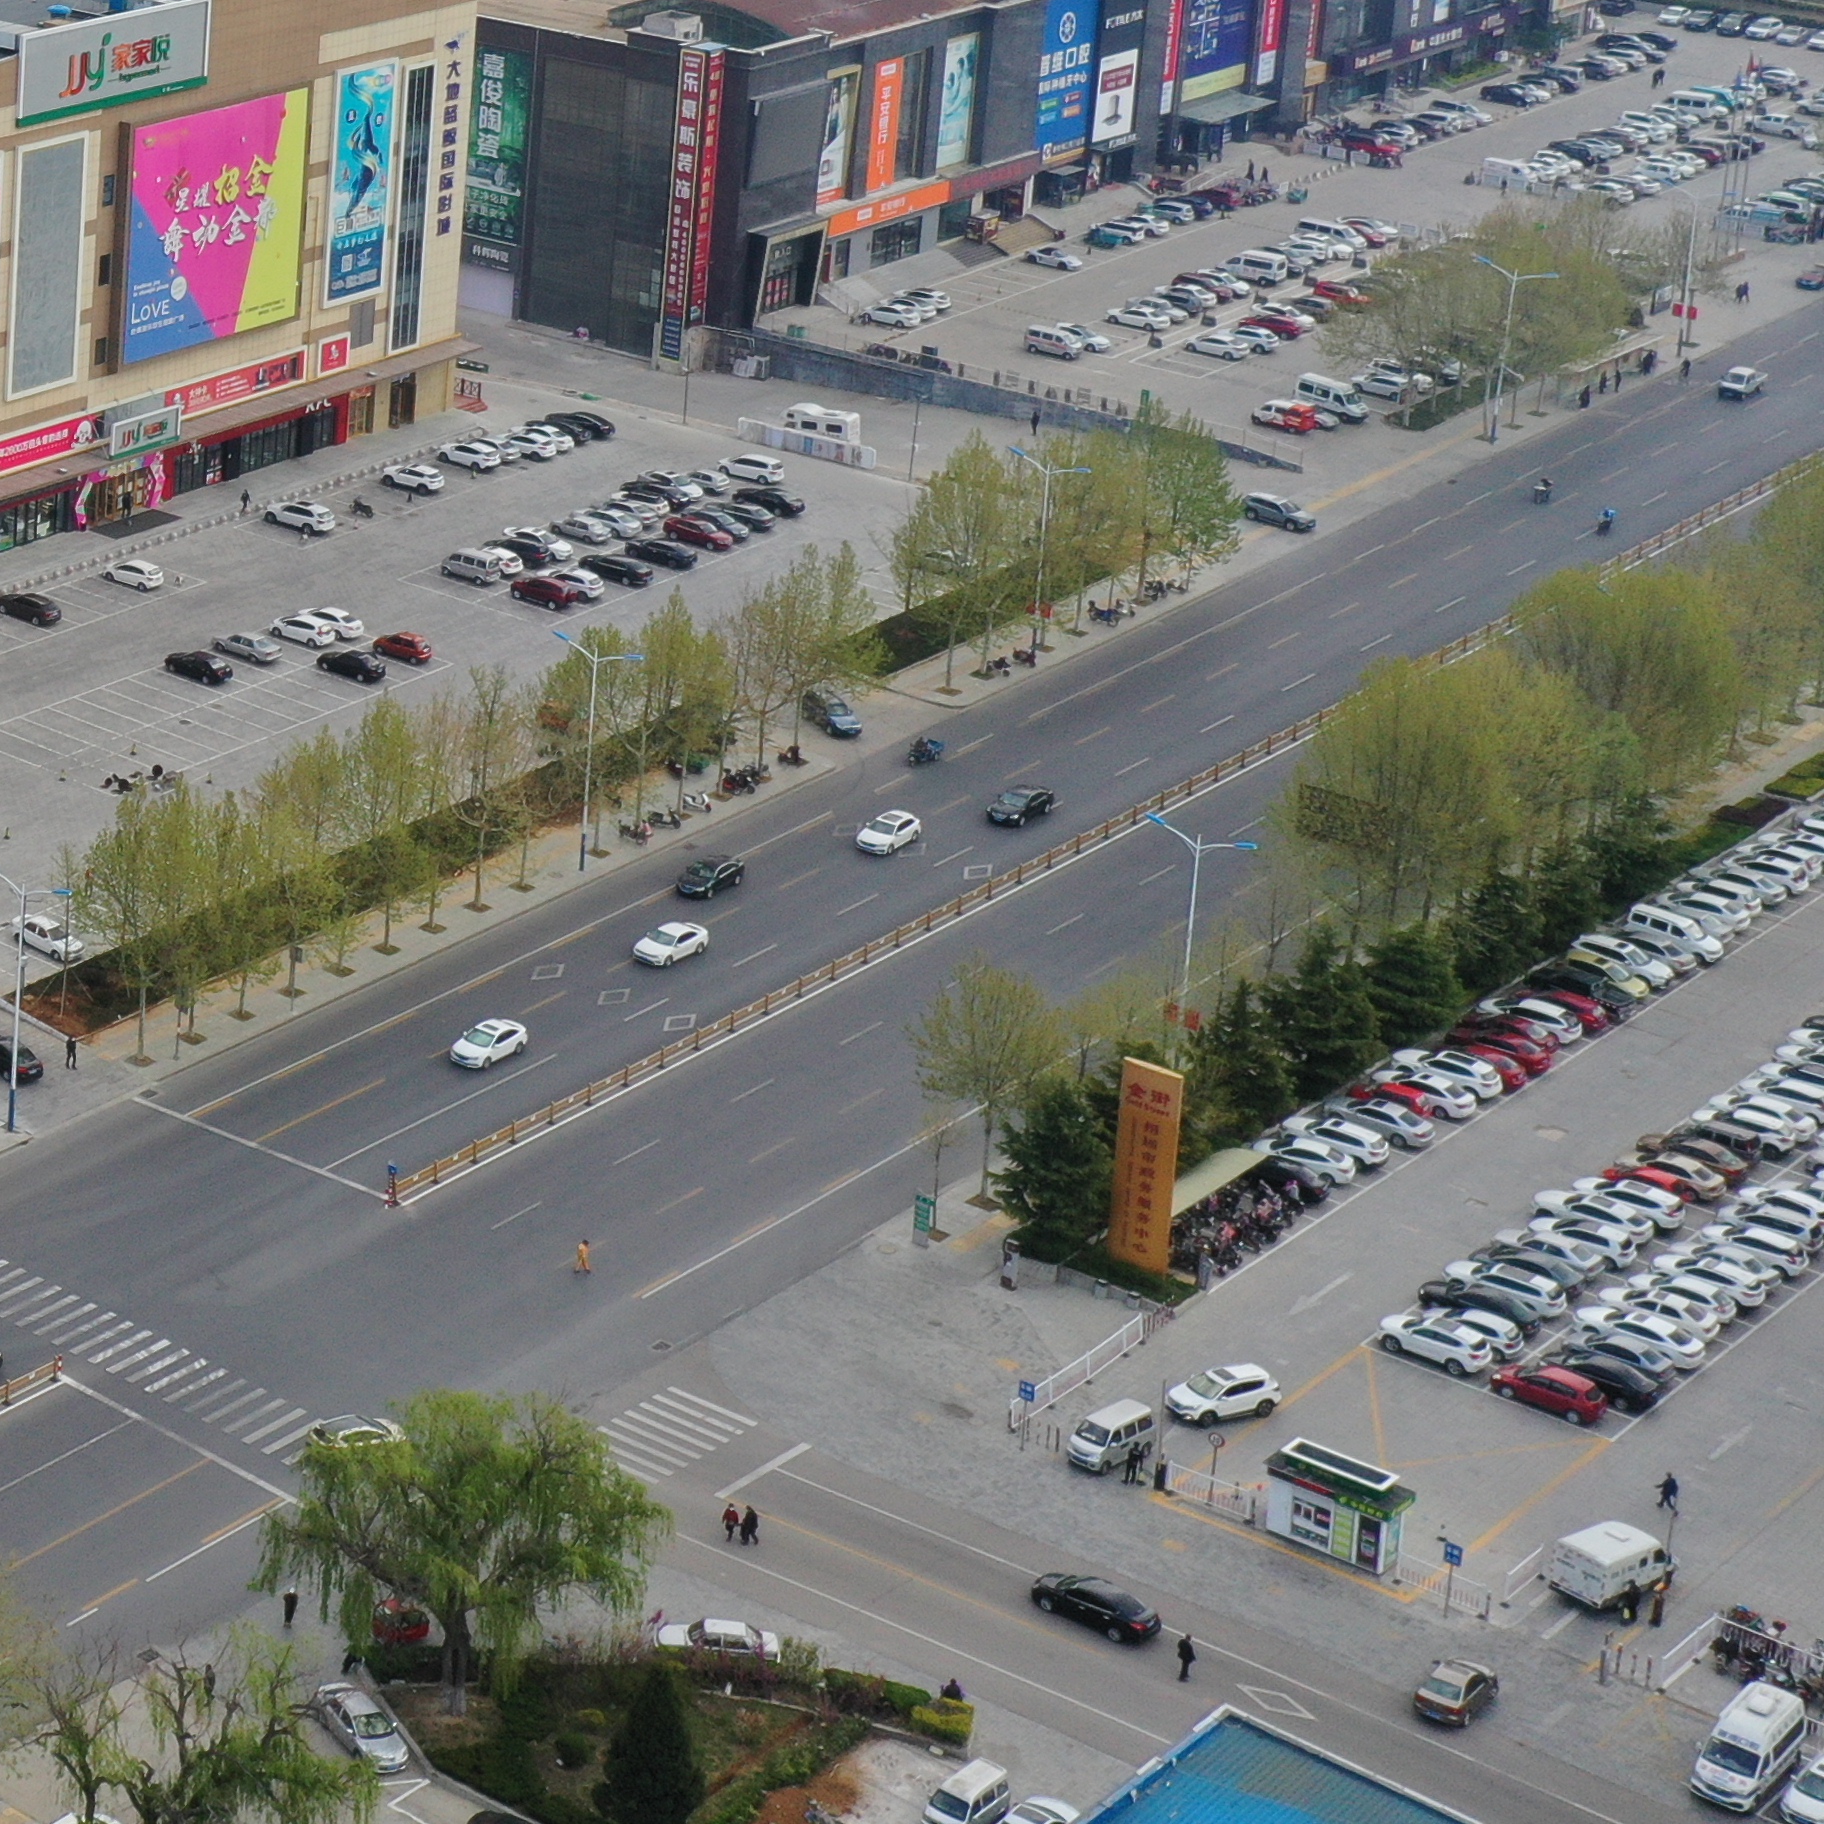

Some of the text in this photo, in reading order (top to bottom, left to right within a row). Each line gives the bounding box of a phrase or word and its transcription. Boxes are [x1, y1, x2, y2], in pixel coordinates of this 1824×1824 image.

[111, 33, 171, 72] 家家悦
[476, 53, 506, 160] 嘉俊陶瓷
[131, 299, 170, 325] LOVE
[1127, 1081, 1172, 1109] 金街
